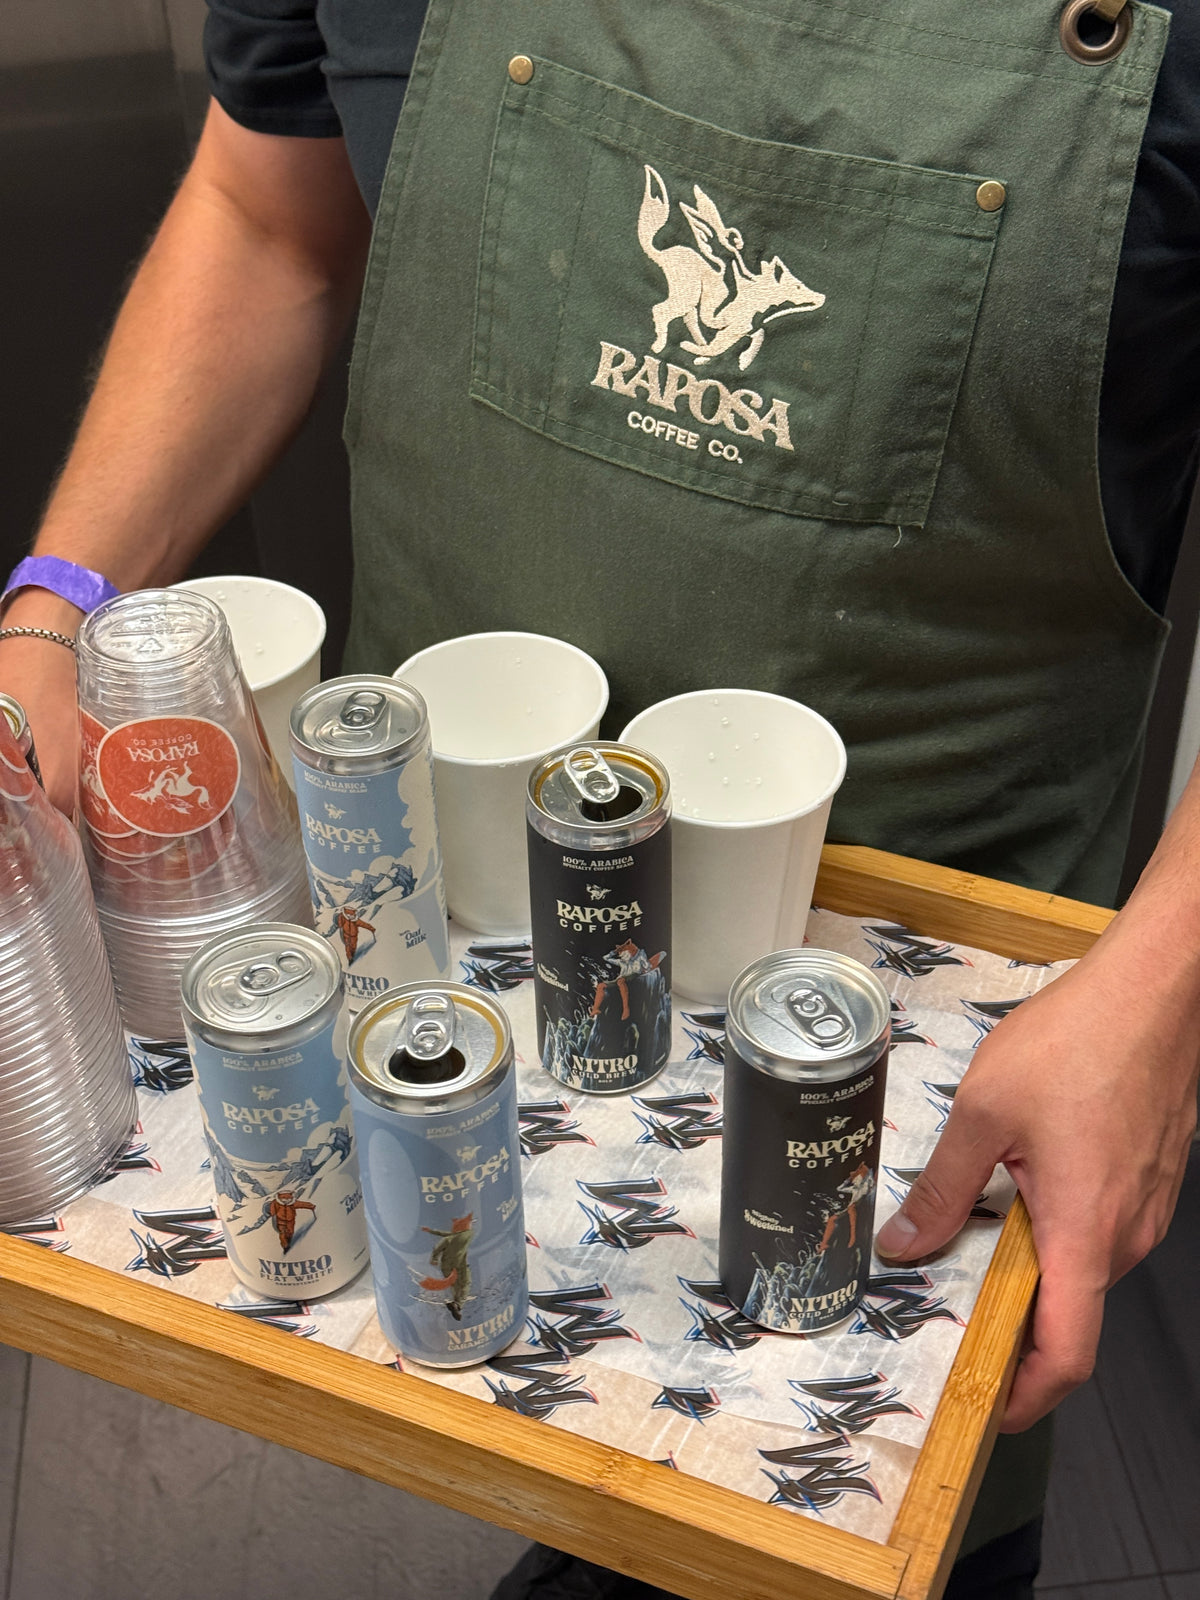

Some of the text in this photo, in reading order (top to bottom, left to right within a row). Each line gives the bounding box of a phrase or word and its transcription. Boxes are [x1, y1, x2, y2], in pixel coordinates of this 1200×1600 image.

[590, 340, 795, 451] RAPOSA
[627, 411, 743, 464] COFFEE CO.
[126, 740, 200, 762] RAPOSA
[152, 734, 192, 746] COFFEE
[325, 780, 367, 789] ARABICA
[305, 812, 382, 844] RAPOSA
[309, 830, 381, 854] COFFEE
[562, 855, 634, 867] 100% ARABICA
[556, 900, 643, 924] RAPOSA
[405, 928, 421, 940] Oat
[559, 916, 641, 933] COFFEE
[406, 933, 427, 949] Milk
[344, 972, 389, 991] TRO
[254, 1052, 303, 1068] ARABICA
[571, 1054, 638, 1074] NITRO
[606, 1068, 637, 1079] BREW
[833, 1075, 874, 1098] ARABICA
[222, 1097, 320, 1125] RAPOSA
[227, 1113, 319, 1135] COFFEE
[786, 1120, 876, 1159] RAPOSA
[788, 1136, 874, 1169] COFFEE
[420, 1146, 510, 1193] RAPOSA
[425, 1161, 509, 1203] COFFEE
[258, 1254, 332, 1276] NITRO
[260, 1267, 333, 1282] FLAT WHITE
[790, 1280, 858, 1313] NITRO
[447, 1304, 514, 1345] NITRO
[789, 1311, 821, 1320] COLD
